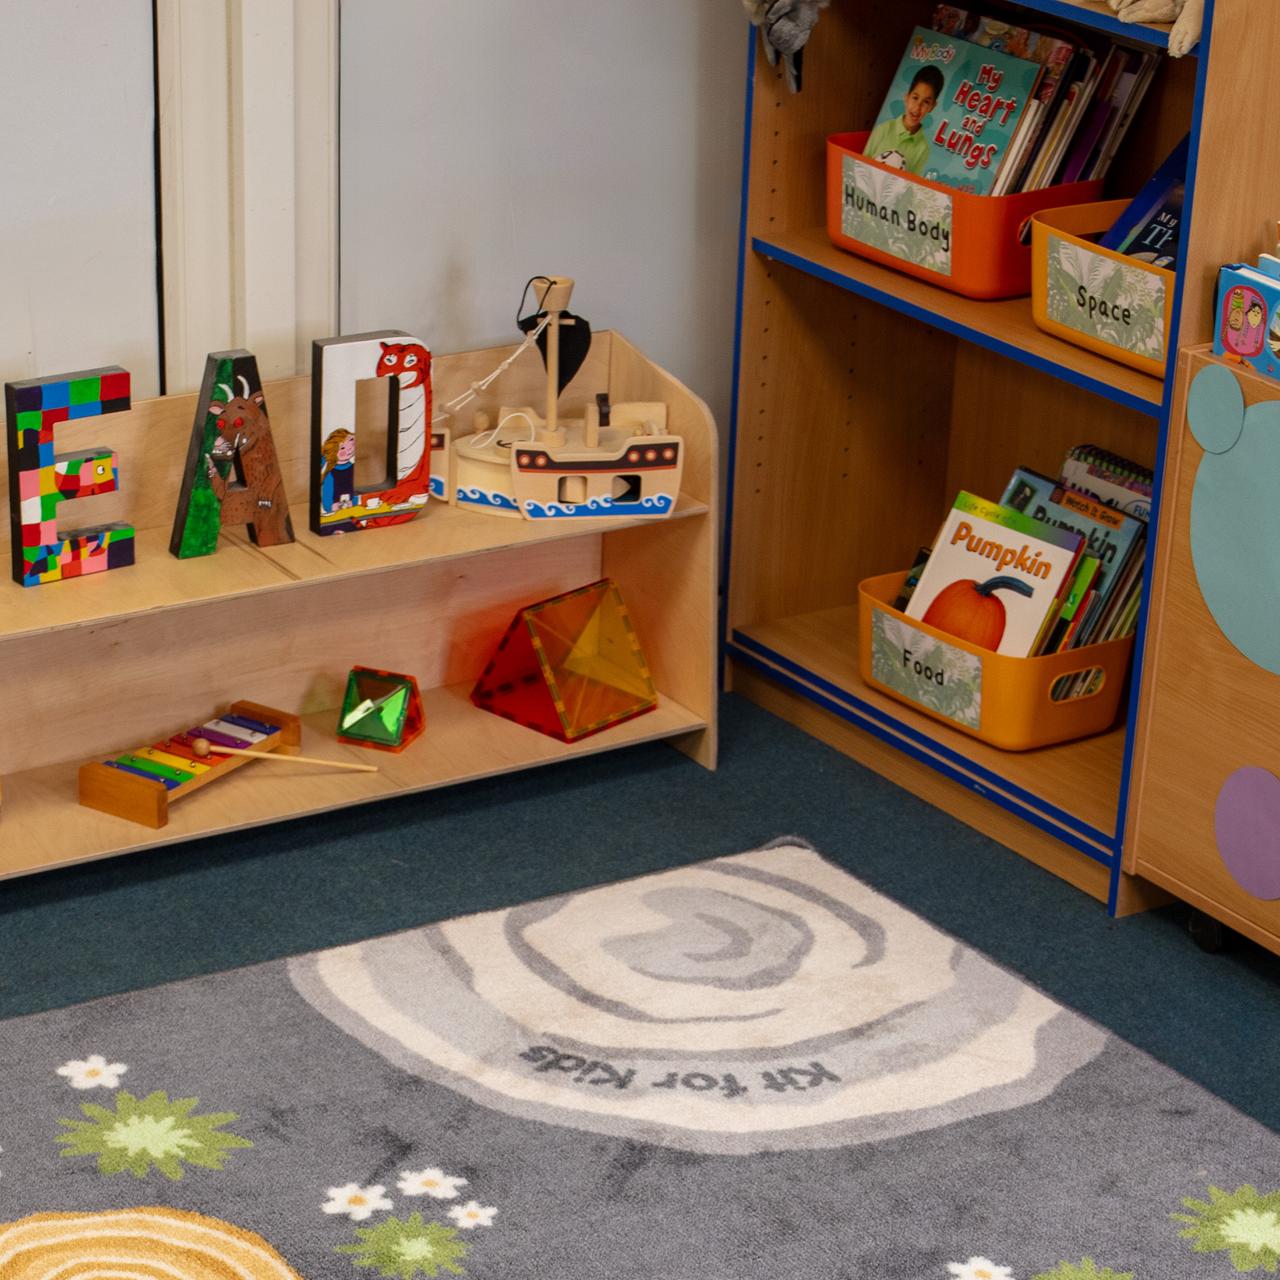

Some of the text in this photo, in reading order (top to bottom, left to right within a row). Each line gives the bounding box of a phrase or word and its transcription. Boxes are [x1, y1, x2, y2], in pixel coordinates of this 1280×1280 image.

[976, 64, 1004, 92] My
[953, 80, 1017, 126] Heart
[961, 114, 987, 136] and
[932, 119, 999, 169] Lungs
[844, 183, 950, 253] Human Body
[1076, 284, 1132, 326] Space
[950, 520, 1053, 580] Pumpkin
[902, 649, 945, 686] Food
[519, 1043, 842, 1099] Kit for Kids
